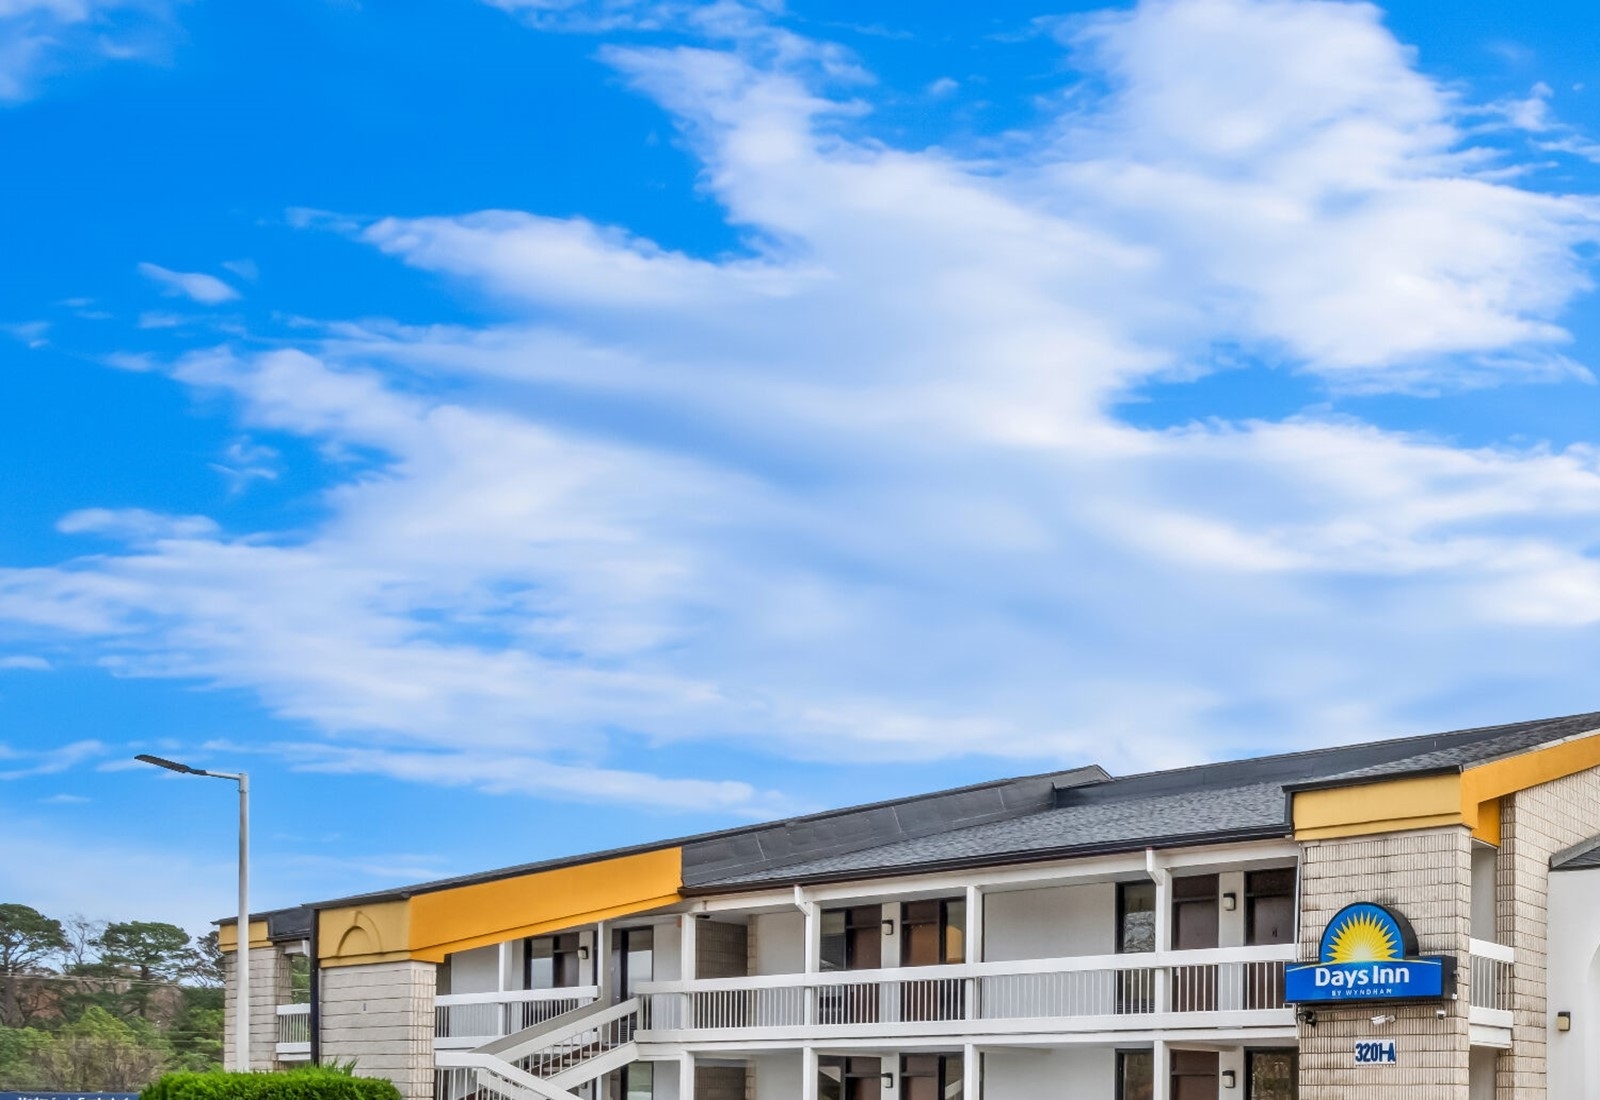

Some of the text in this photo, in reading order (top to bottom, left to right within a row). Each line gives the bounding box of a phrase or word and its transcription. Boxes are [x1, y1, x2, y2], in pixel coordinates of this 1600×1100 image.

[1315, 965, 1410, 989] Days Inn
[1346, 988, 1392, 996] WYNDHAM
[1355, 1042, 1396, 1062] 3201-A
